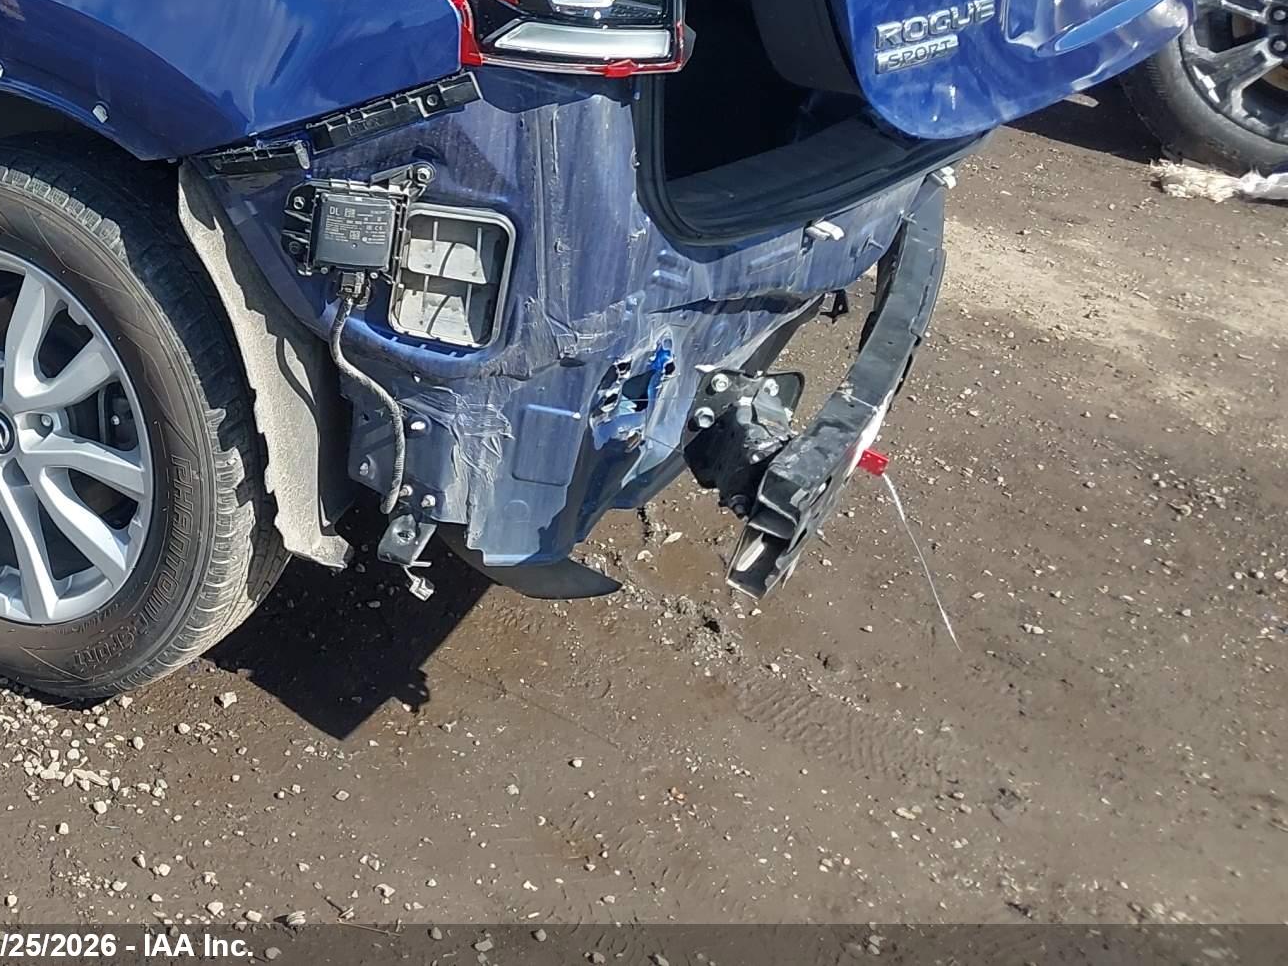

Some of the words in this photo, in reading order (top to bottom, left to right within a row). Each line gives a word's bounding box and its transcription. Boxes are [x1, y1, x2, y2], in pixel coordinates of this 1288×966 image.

[887, 38, 953, 68] SPORT
[329, 205, 340, 216] DL
[142, 454, 195, 622] PHANTOM
